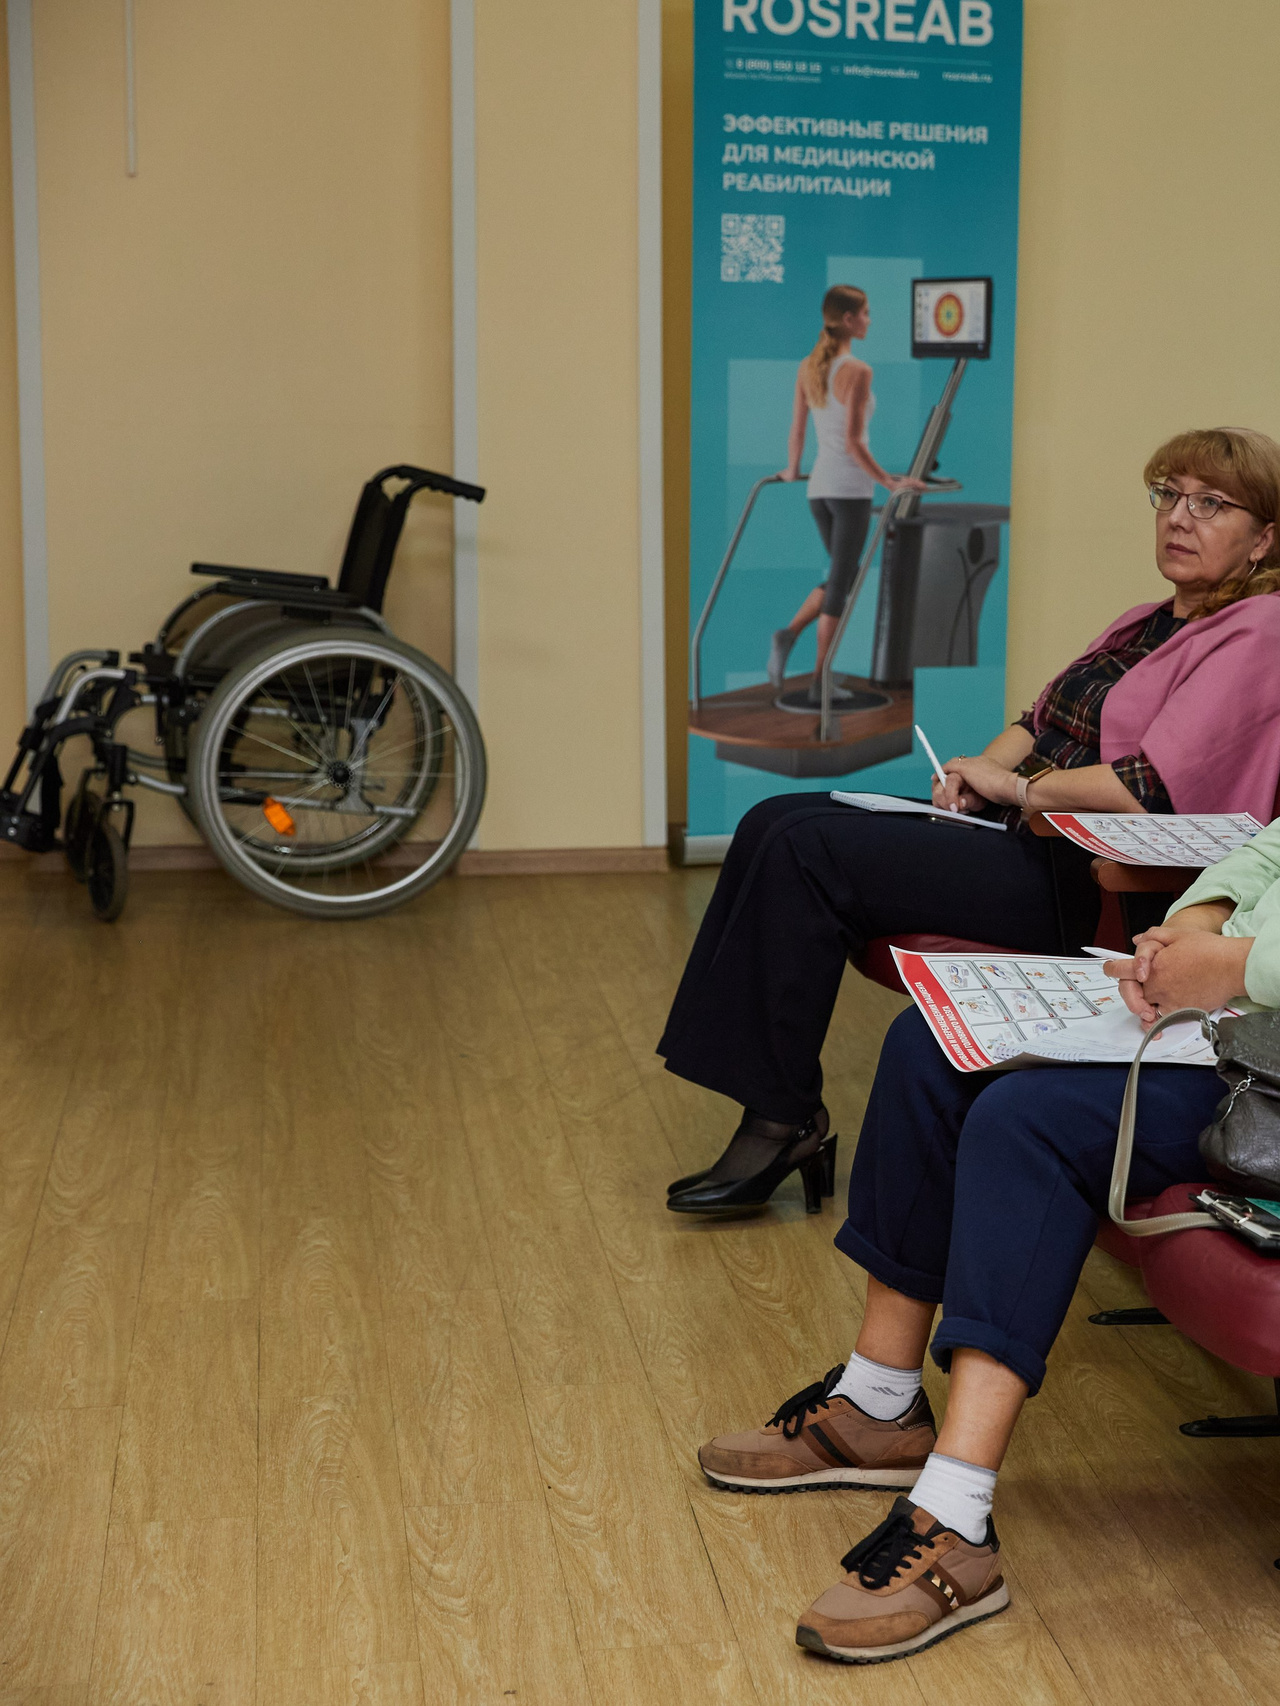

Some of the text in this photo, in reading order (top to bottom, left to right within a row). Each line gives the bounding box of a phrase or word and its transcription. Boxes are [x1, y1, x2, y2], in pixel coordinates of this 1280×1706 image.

[723, 0, 994, 47] ROSREAB
[723, 114, 988, 144] ЭФФЕКТИВНЫЕ РЕШЕНИЯ
[722, 143, 935, 171] ДЛЯ МЕДИЦИНСКОЙ
[722, 172, 891, 199] РЕАБИЛИТАЦИИ
